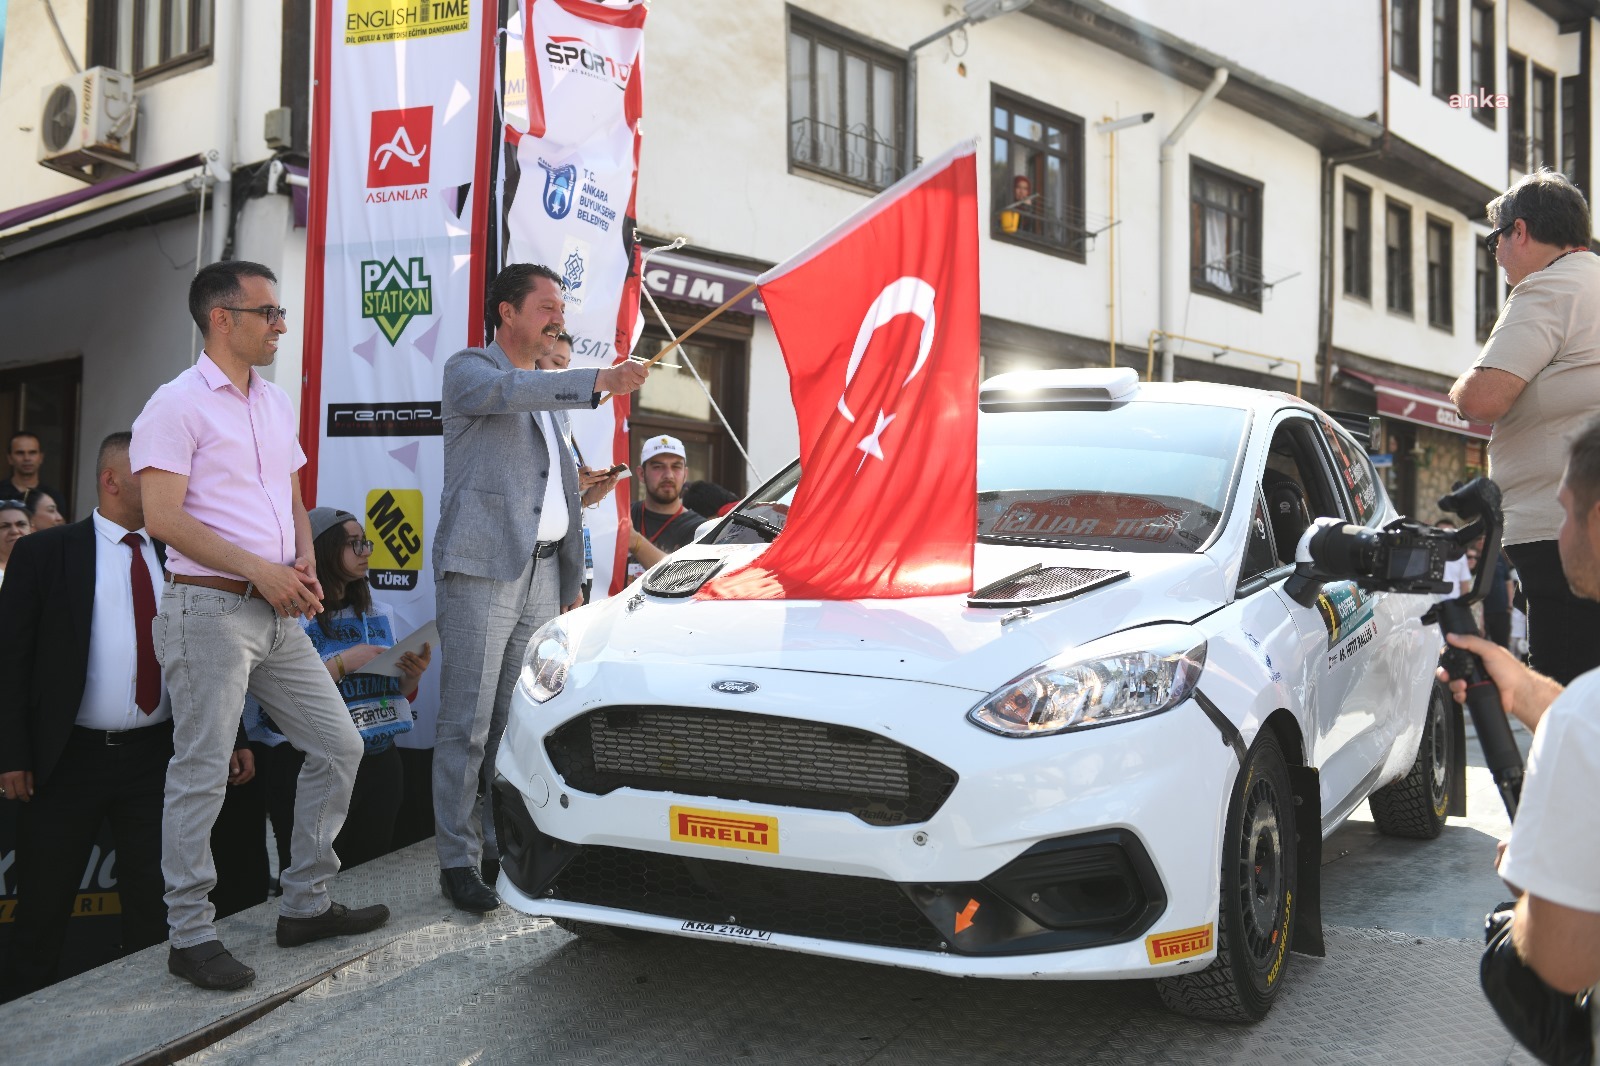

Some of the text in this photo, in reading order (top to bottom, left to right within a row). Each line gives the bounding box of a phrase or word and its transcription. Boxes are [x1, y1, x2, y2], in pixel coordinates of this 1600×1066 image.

[346, 0, 469, 30] ENGLISH TIME
[365, 188, 428, 204] ASLANLAR
[581, 182, 608, 203] ANKARA
[364, 260, 429, 292] PAL
[364, 288, 430, 315] STATION
[376, 572, 410, 586] TÜRK
[677, 813, 769, 846] PIRELLI
[685, 920, 768, 938] KRA 2140 V
[1152, 929, 1210, 959] PIRELLI
